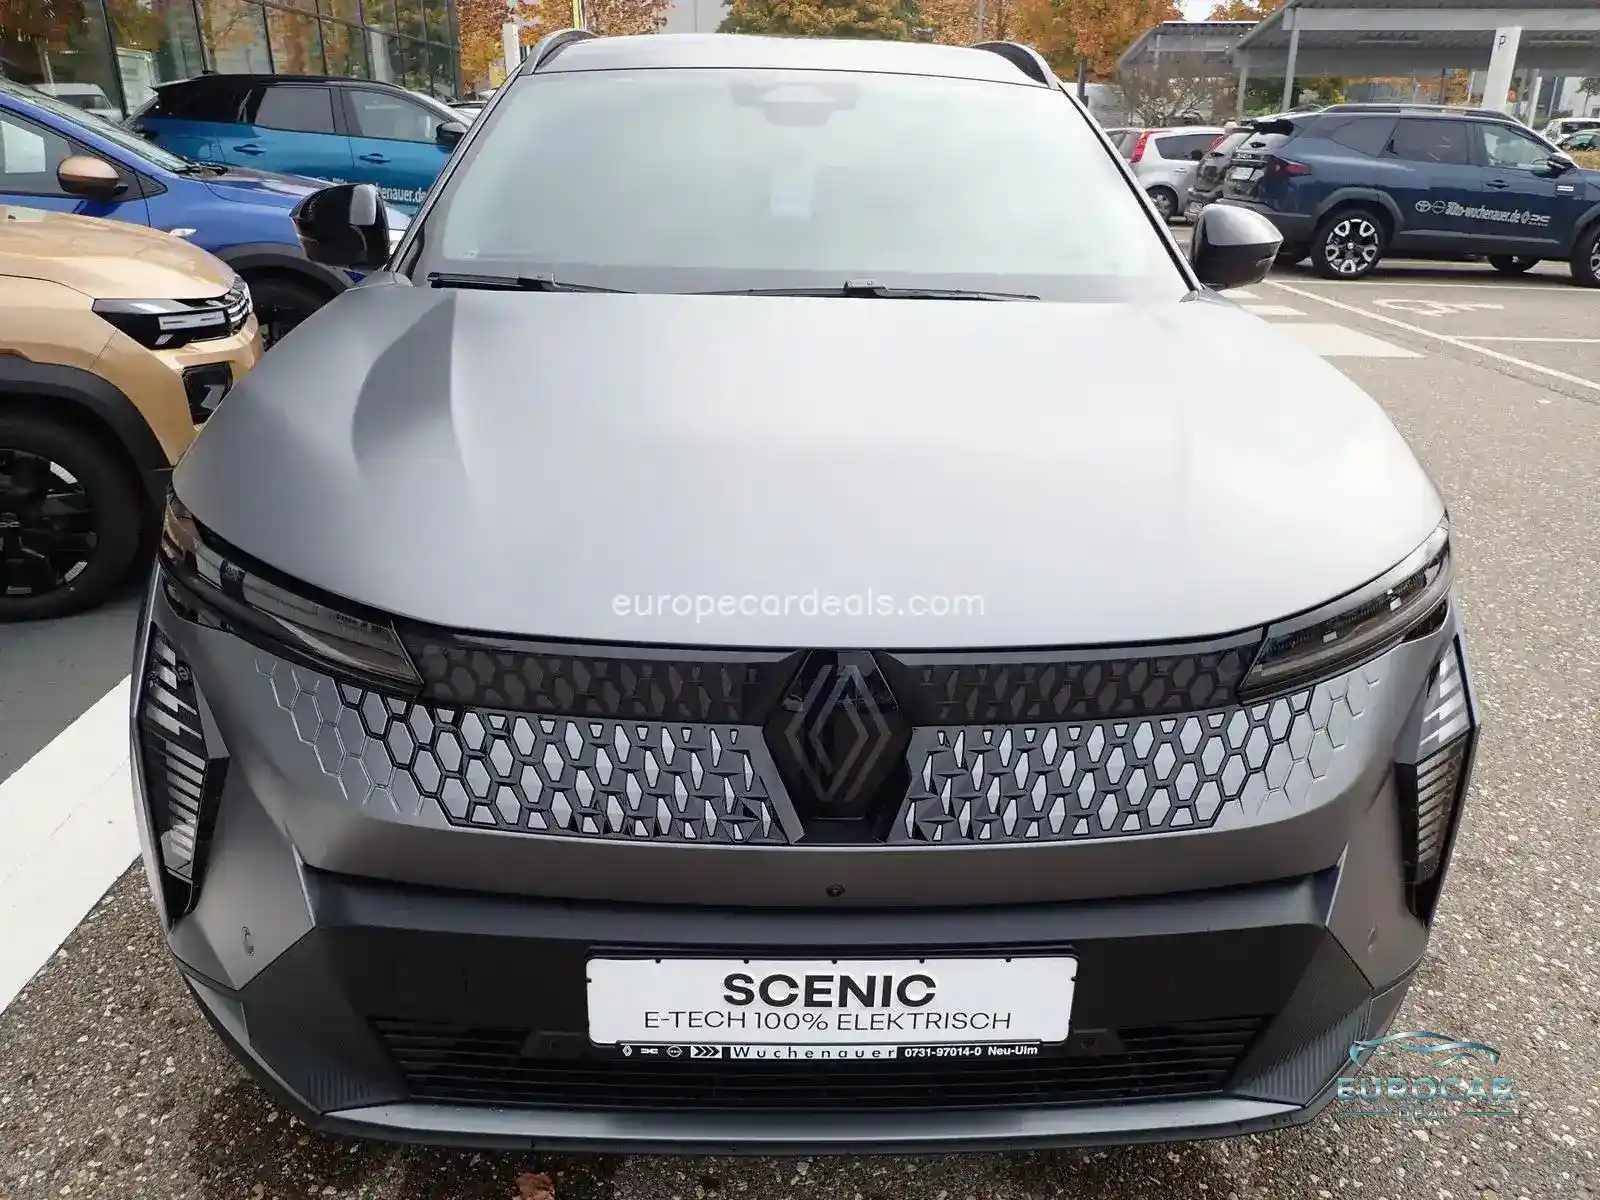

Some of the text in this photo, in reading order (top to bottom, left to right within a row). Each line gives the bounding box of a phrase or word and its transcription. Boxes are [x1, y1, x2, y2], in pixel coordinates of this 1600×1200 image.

[723, 973, 937, 1008] SCENIC
[644, 1011, 1011, 1032] E-TECH 100% ELEKTRISCH
[733, 1046, 1038, 1059] Wuchenauer 0731-97014-0 Neu-Ulm
